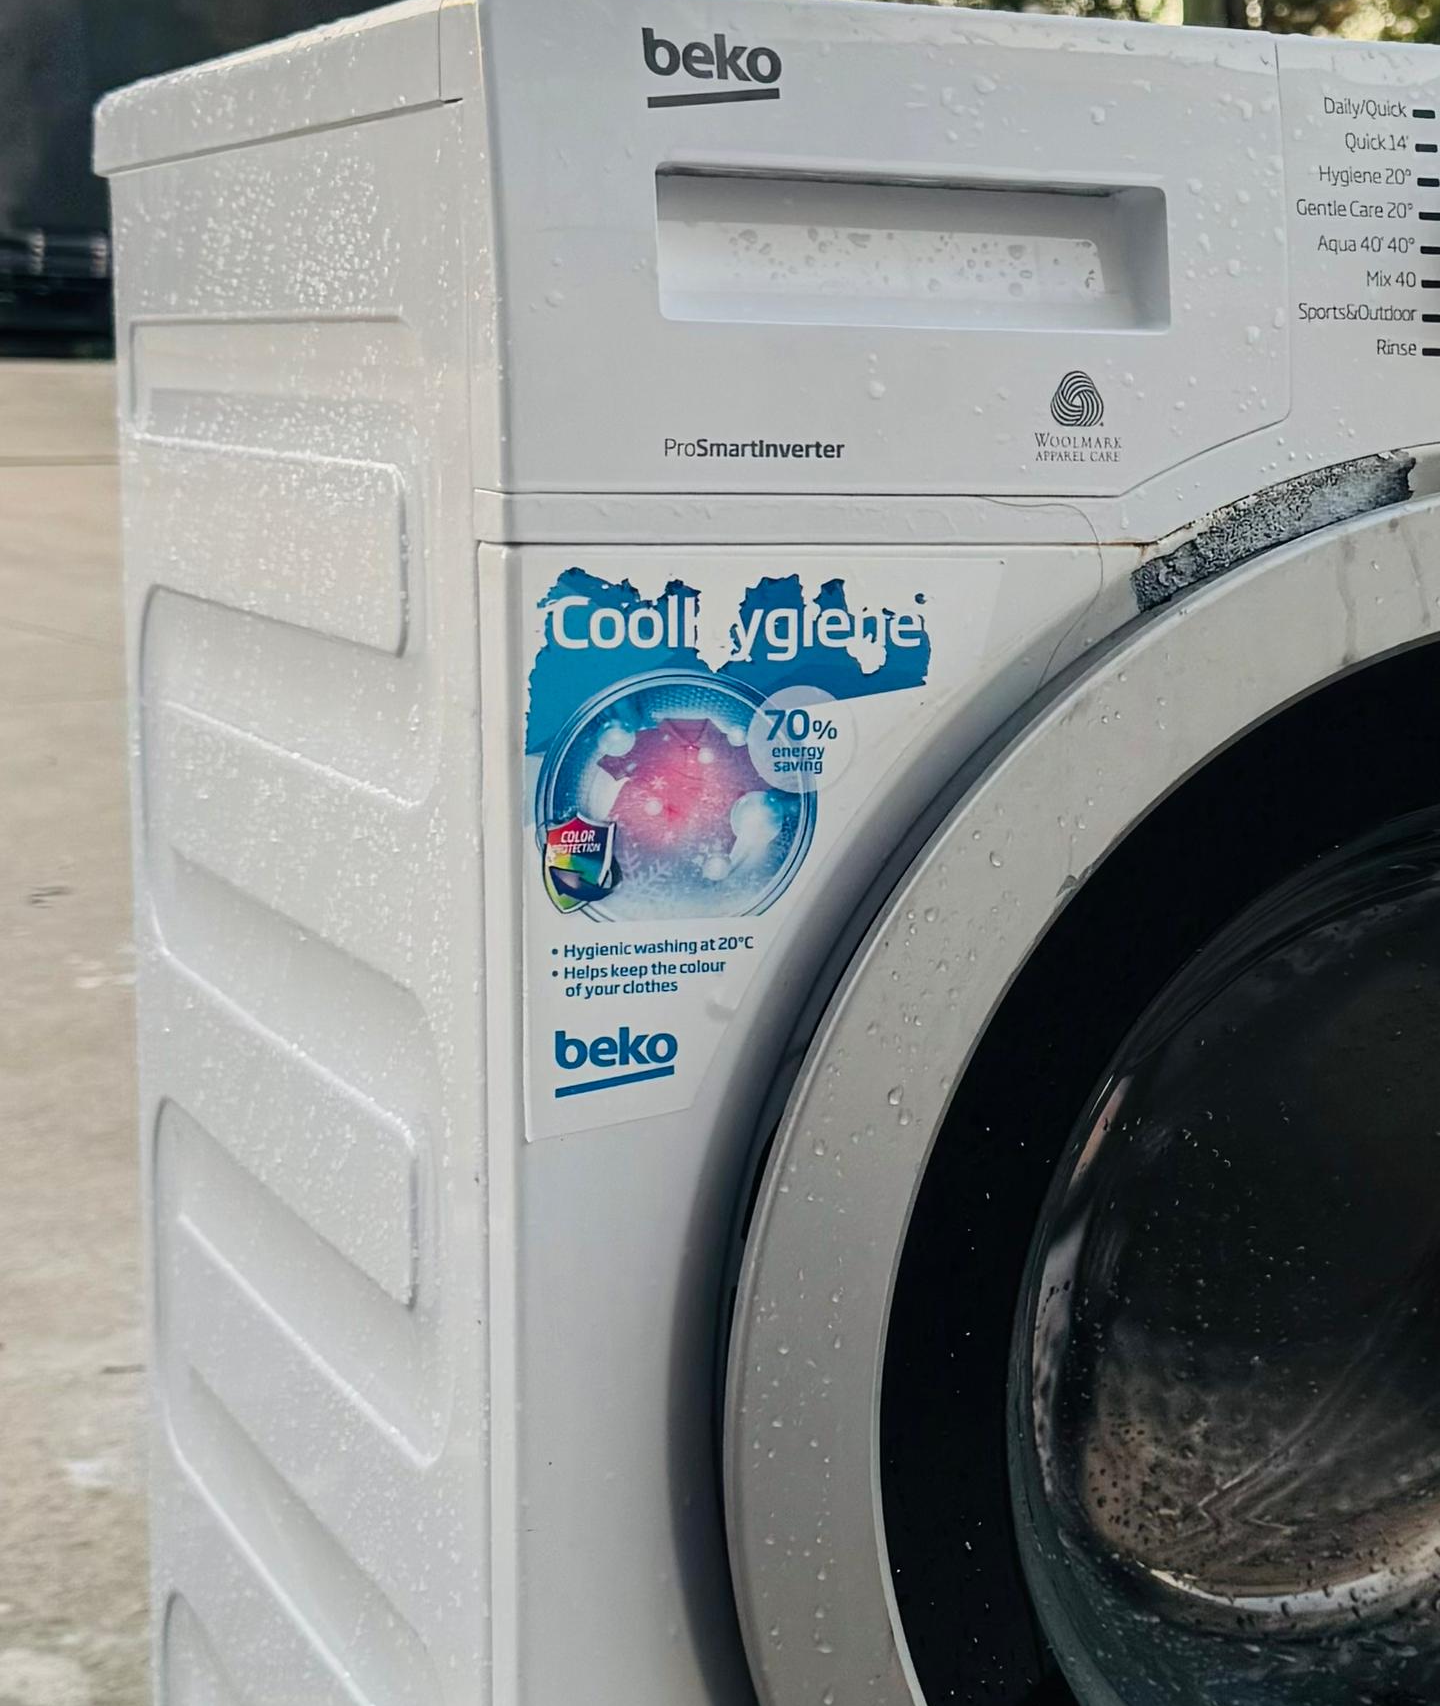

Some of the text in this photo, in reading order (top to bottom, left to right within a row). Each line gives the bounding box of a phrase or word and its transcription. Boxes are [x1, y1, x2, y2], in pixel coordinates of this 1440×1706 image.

[641, 27, 782, 84] beko
[1324, 96, 1408, 120] Daily/Quick
[1345, 132, 1386, 153] Quick
[1318, 164, 1382, 187] Hygiene
[1296, 198, 1347, 217] Gentle
[1350, 200, 1384, 218] Care
[1317, 234, 1357, 255] Aqua
[1366, 270, 1417, 288] Mix 40
[1298, 302, 1418, 323] Sports&Outdoor
[1376, 338, 1417, 356] Rinse
[664, 437, 845, 460] ProSmartInverter
[1034, 431, 1122, 449] WOOLMARK
[1035, 450, 1121, 463] APPAREL CARE
[764, 708, 838, 742] 70%
[771, 746, 826, 761] energy
[773, 757, 824, 774] saving
[561, 830, 596, 844] COLOR
[564, 936, 754, 961] Hygienic washing at 20°C
[564, 959, 727, 981] Helps keep the colour
[565, 979, 678, 1000] of your clothes
[554, 1026, 678, 1070] beko
